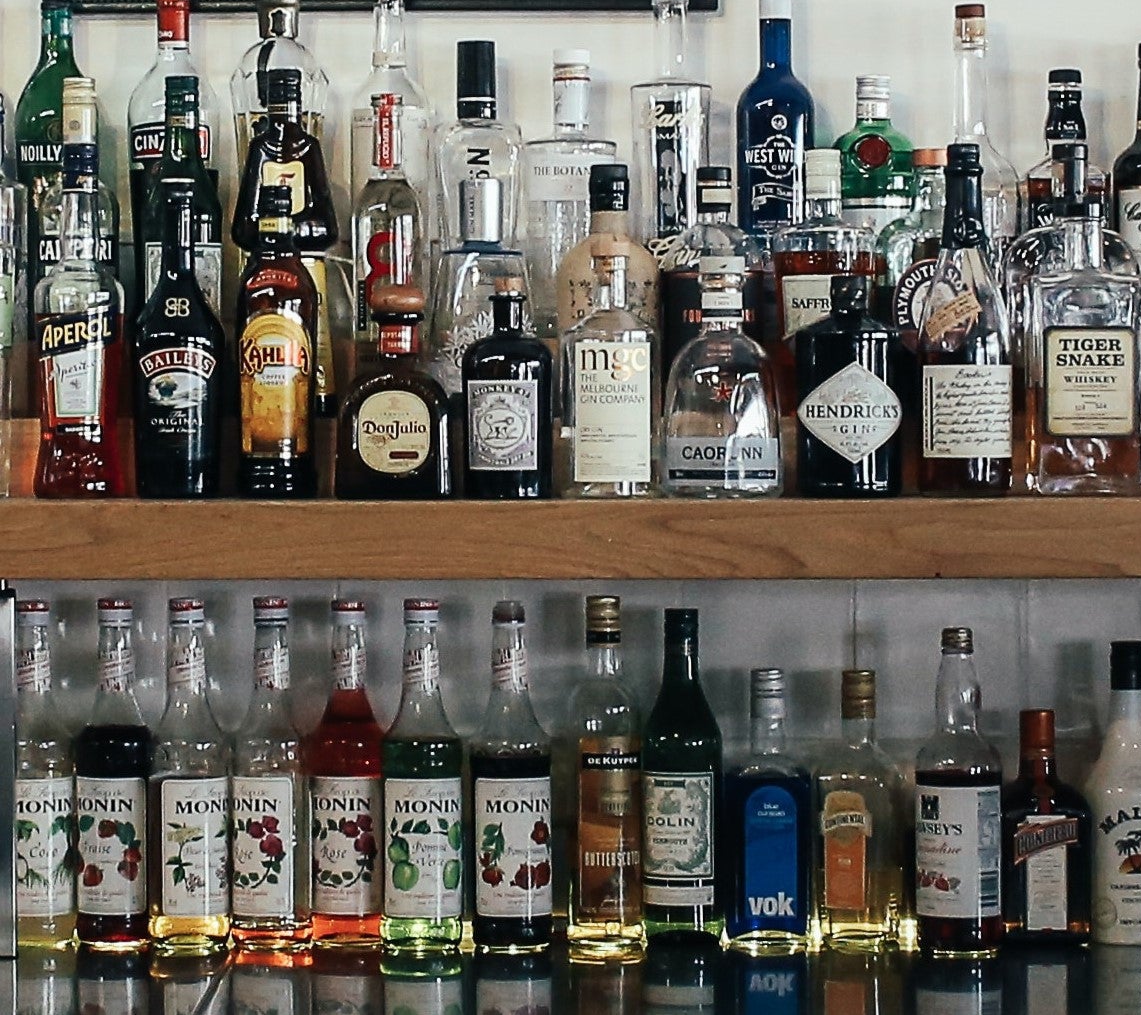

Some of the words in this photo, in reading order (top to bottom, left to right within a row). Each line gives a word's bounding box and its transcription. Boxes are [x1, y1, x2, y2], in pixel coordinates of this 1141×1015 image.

[20, 144, 62, 162] NOILLY
[744, 149, 776, 164] WEST
[42, 318, 112, 351] APEROL
[1058, 337, 1122, 352] TIGER
[145, 350, 212, 373] BAILEYS
[239, 337, 310, 375] KAHLA
[580, 344, 647, 381] mgc
[1056, 353, 1125, 368] SNAKE
[580, 374, 598, 384] THE
[1063, 375, 1117, 384] WHISKEY
[580, 384, 639, 394] MELBOURNE
[580, 395, 597, 405] GIN
[599, 395, 646, 405] COMPANY
[805, 404, 899, 420] HENDRICK'S
[839, 424, 871, 434] GIN
[394, 798, 460, 813] MONIN
[485, 798, 550, 813] MONIN
[748, 892, 795, 917] vok
